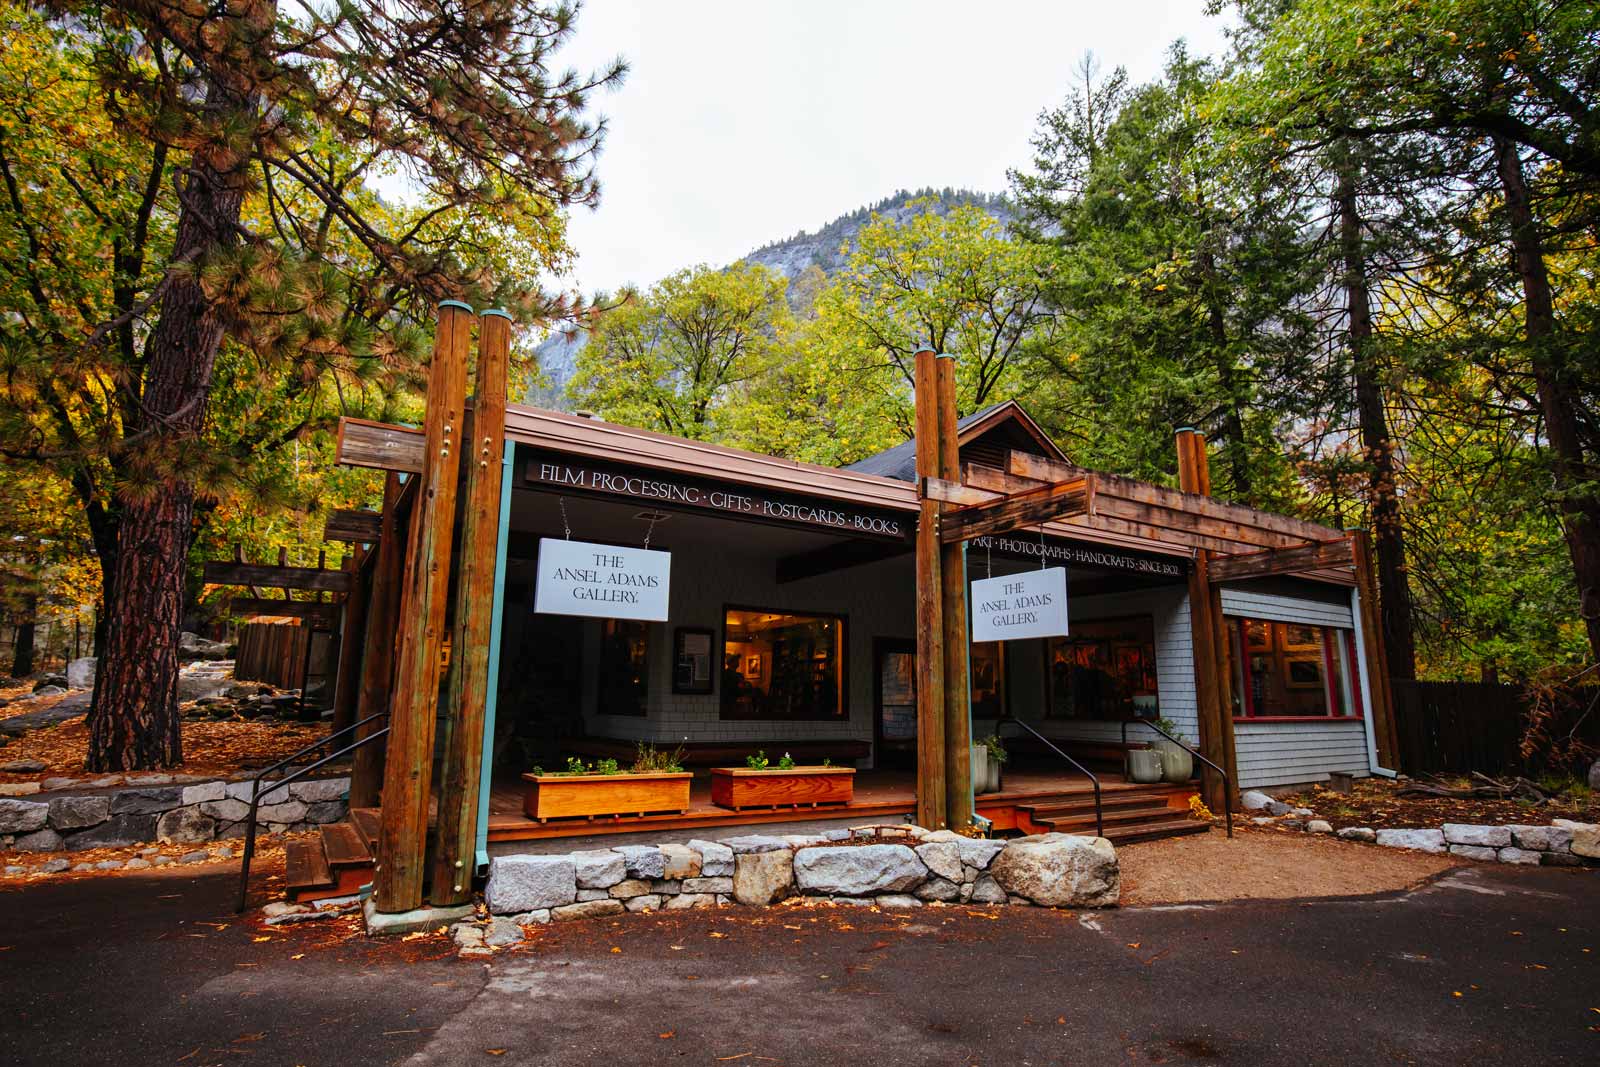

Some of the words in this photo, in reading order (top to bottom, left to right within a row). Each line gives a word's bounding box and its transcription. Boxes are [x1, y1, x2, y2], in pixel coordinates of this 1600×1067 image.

[540, 464, 585, 486] FILM
[591, 471, 700, 503] PROCESSING
[710, 492, 752, 512] GIFTS
[763, 501, 845, 526] POSTCARDS
[854, 515, 899, 535] BOOKS
[592, 554, 625, 568] THE
[972, 536, 994, 548] ART
[1000, 539, 1071, 560] PHOTOGRAPHS
[1076, 550, 1136, 569] HANDCRAFTS
[1139, 560, 1162, 573] SINCE
[553, 567, 602, 583] ANSEL
[607, 572, 659, 588] ADAMS
[1003, 581, 1025, 596] THE
[980, 600, 1011, 613] ANSEL
[1014, 593, 1052, 609] ADAMS
